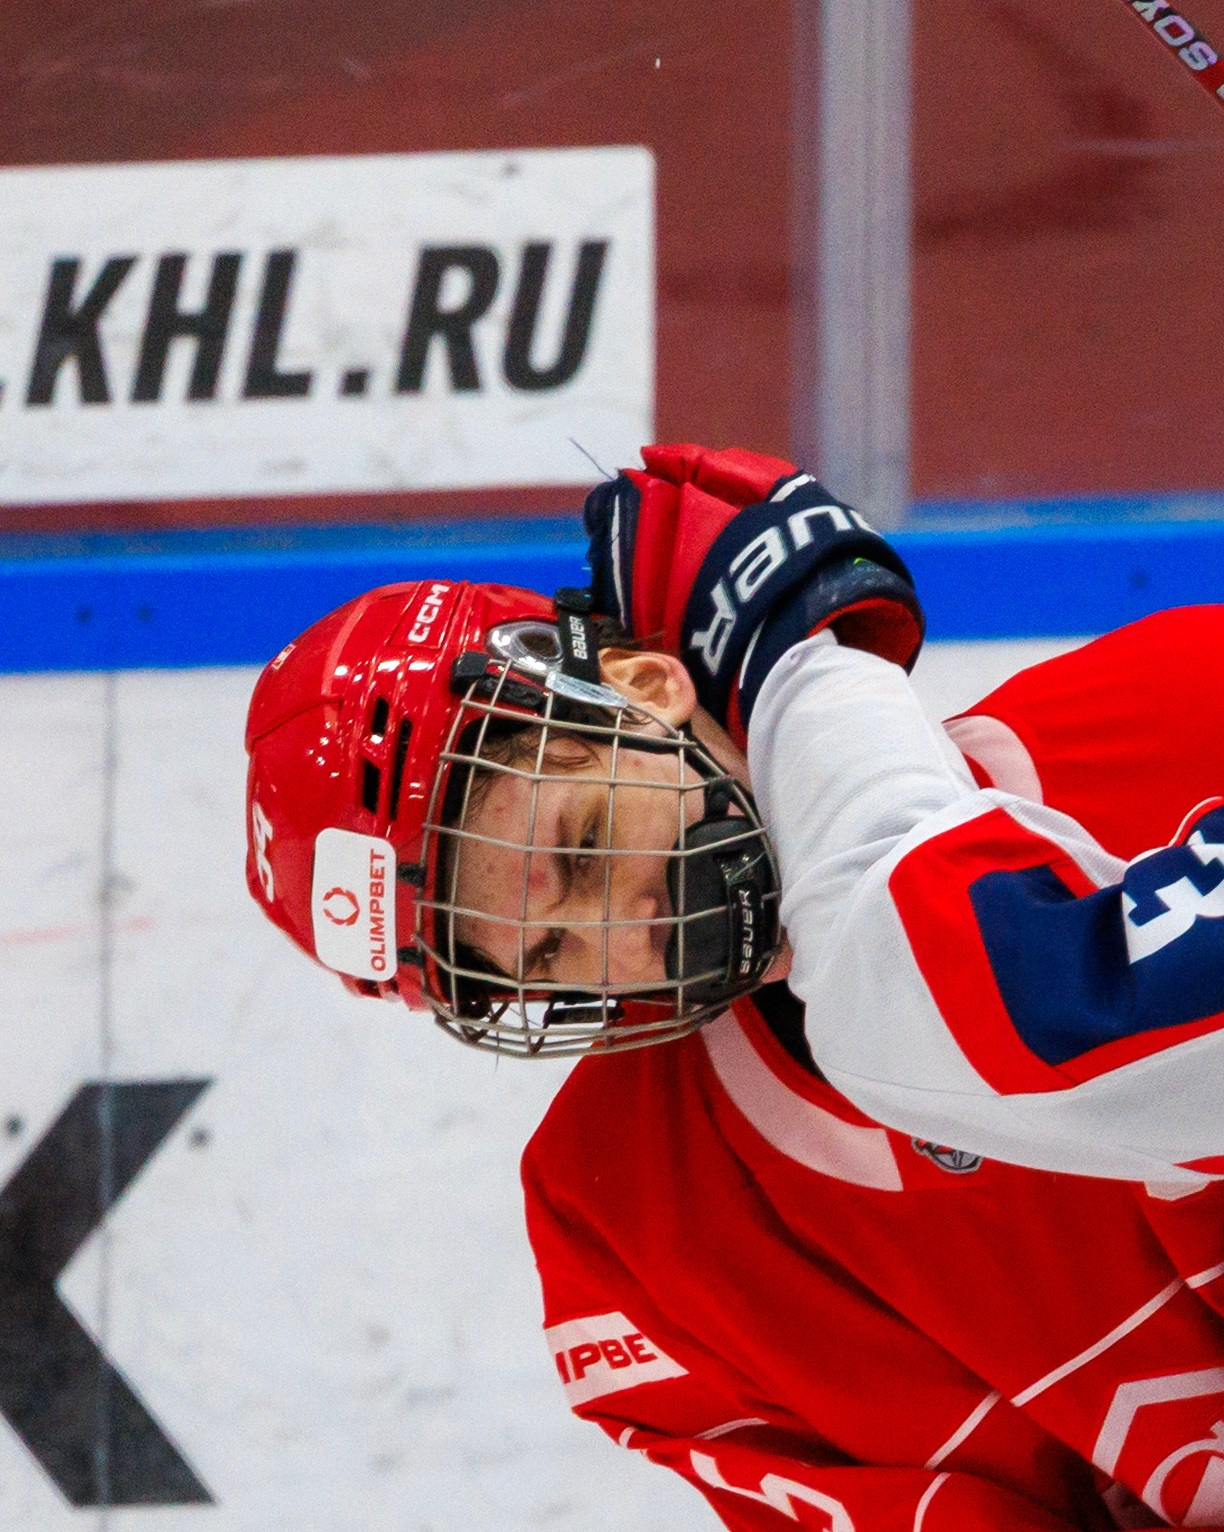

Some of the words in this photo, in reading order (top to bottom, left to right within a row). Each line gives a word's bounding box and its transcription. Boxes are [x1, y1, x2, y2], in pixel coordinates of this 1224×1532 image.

[0, 239, 611, 409] KHL.RU
[407, 584, 450, 644] CCM
[369, 848, 387, 972] OLIMPBET
